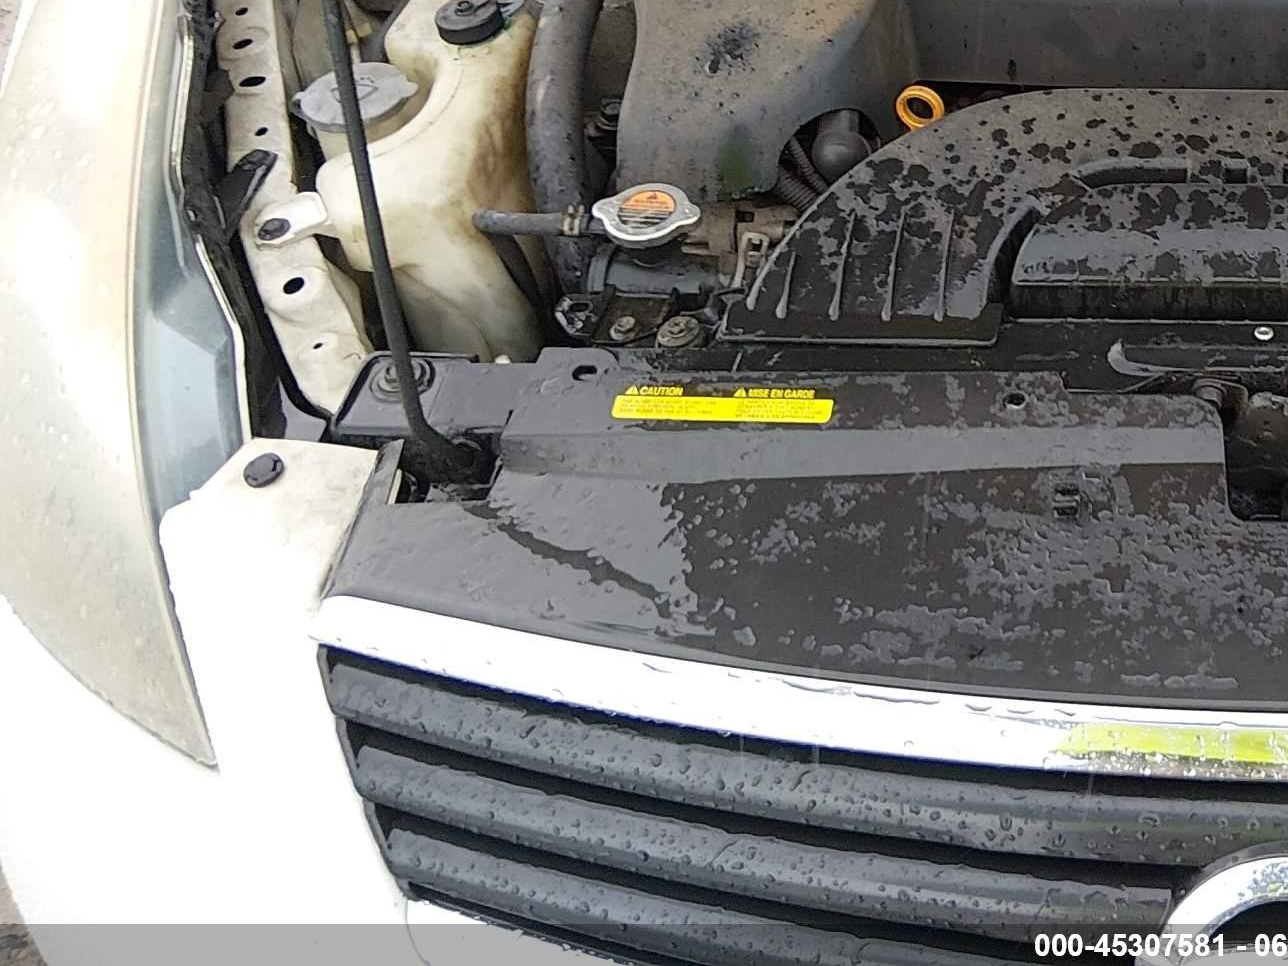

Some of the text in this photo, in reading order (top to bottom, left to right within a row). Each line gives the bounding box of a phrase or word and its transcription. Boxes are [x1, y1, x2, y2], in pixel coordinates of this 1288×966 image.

[640, 386, 684, 396] CAUTION
[747, 388, 815, 399] MISE EN GARDE
